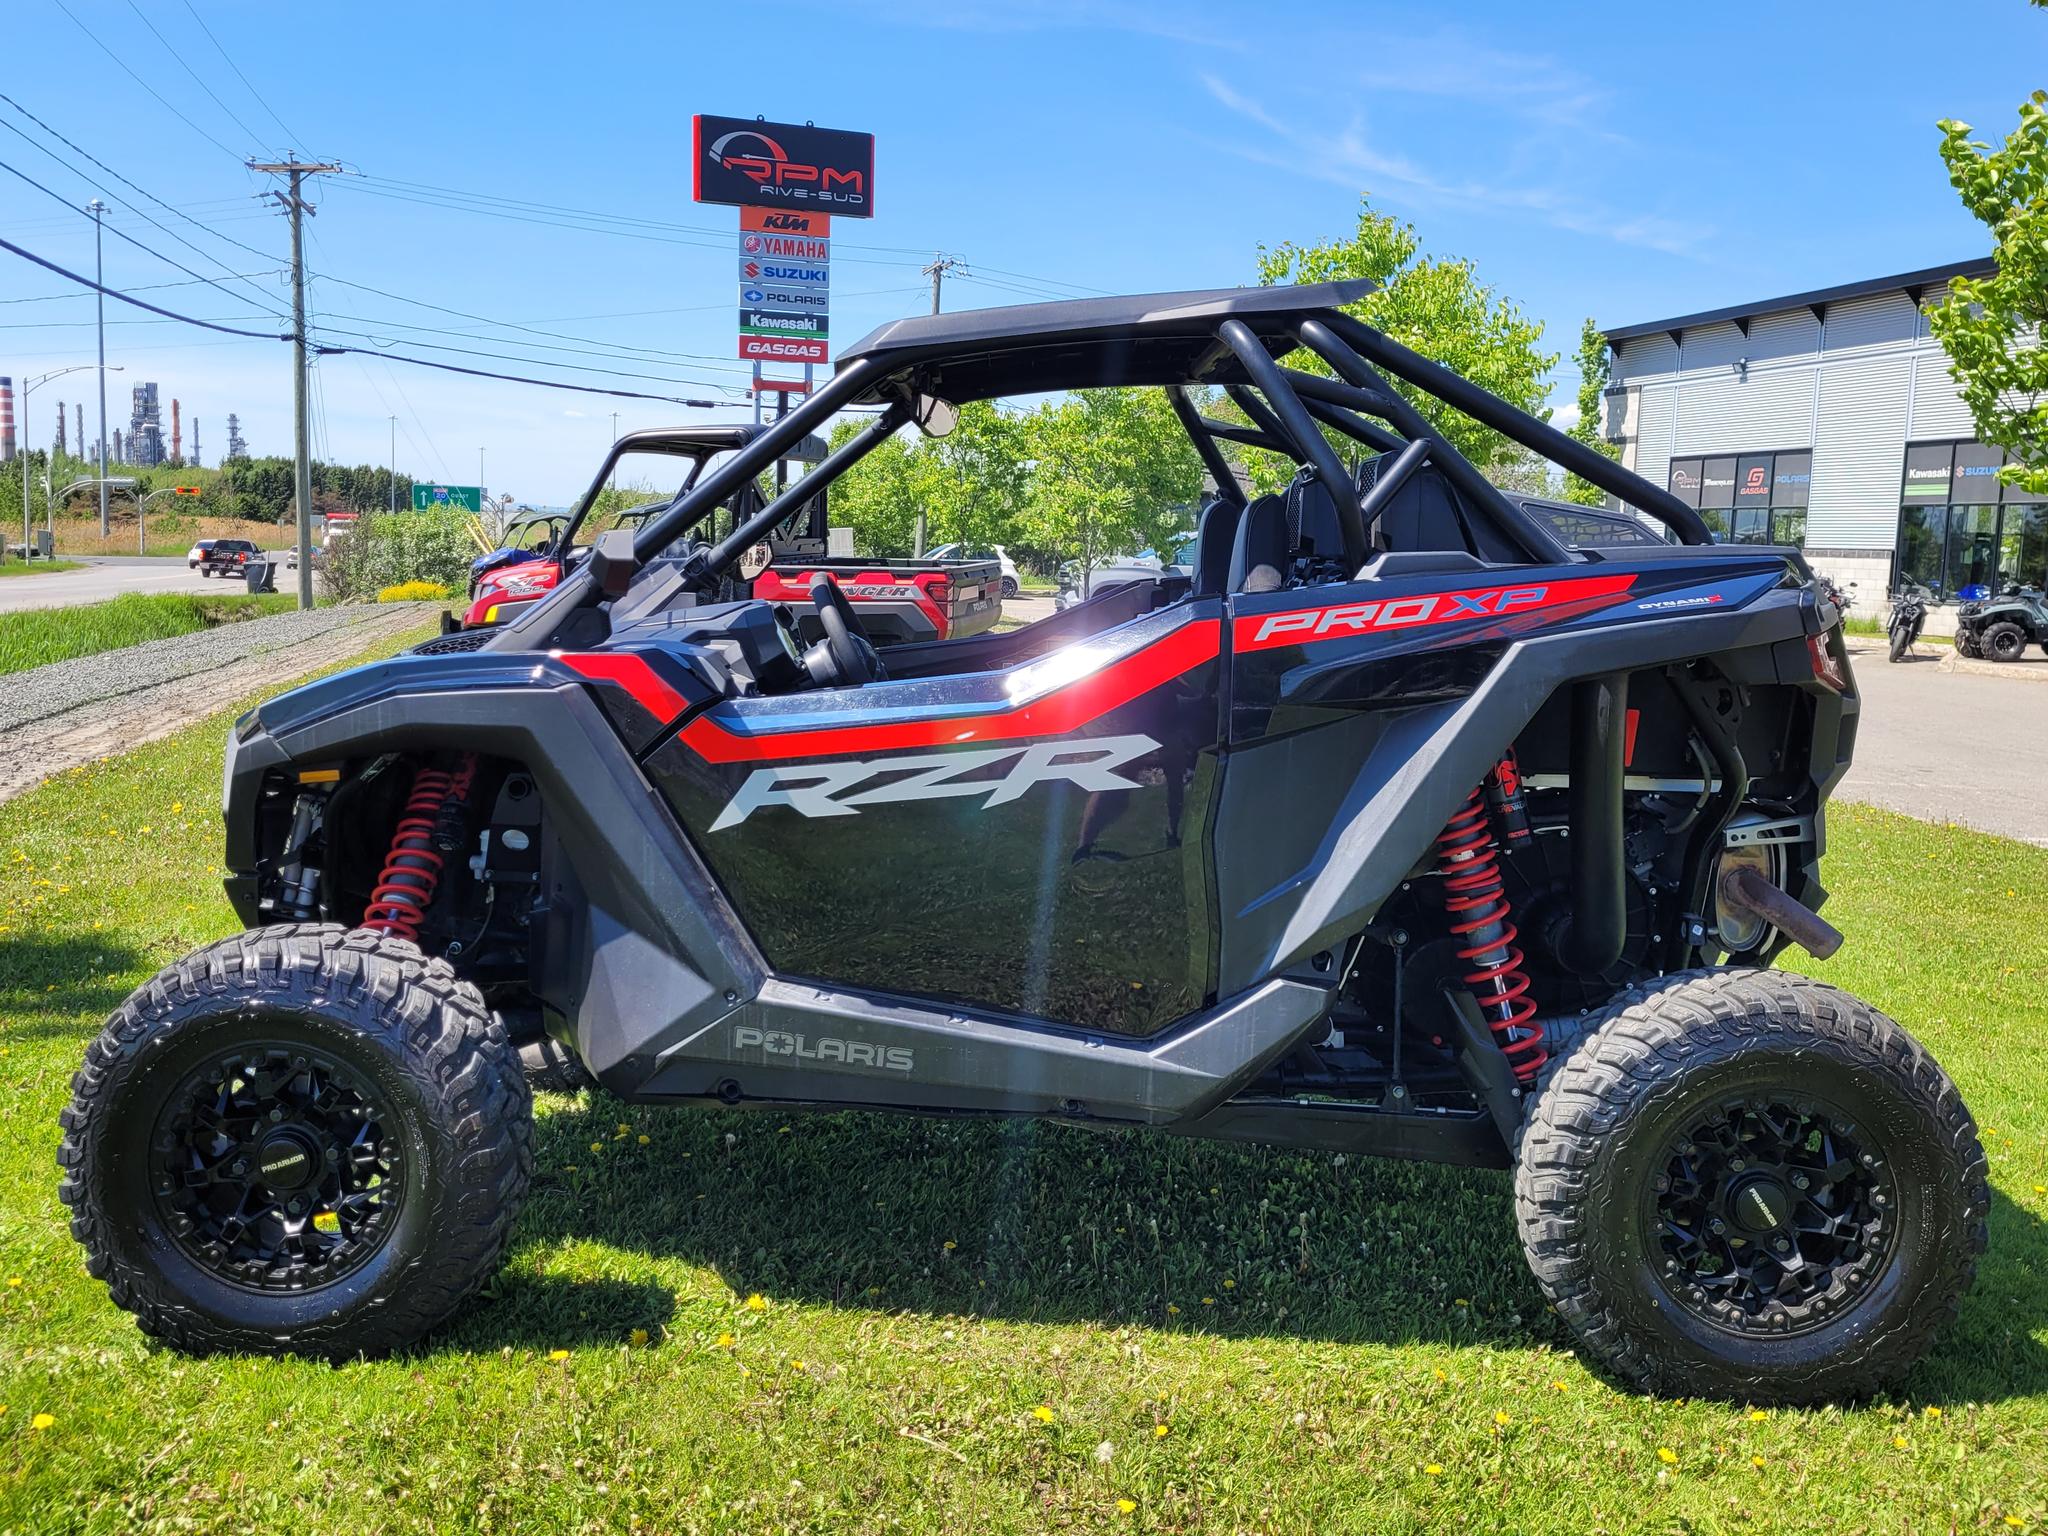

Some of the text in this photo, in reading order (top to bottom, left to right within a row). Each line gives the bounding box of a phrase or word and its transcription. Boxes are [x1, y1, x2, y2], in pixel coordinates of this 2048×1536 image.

[723, 157, 863, 192] RPM
[760, 185, 864, 203] RIVE-SUD
[762, 213, 810, 231] KTM
[763, 237, 827, 259] YAMAHA
[763, 266, 827, 282] SUZUKI
[766, 293, 826, 306] POLARIS
[750, 314, 818, 331] Kawasaki
[747, 342, 822, 357] GASGAS
[1775, 474, 1809, 484] POLARIS
[1909, 467, 1951, 479] Kawasaki
[1965, 465, 2000, 476] SUZUK
[1740, 487, 1769, 495] GASGAS
[1254, 587, 1549, 641] PRO XP
[708, 734, 1163, 833] RZR
[734, 1027, 914, 1072] POLARIS
[261, 1153, 305, 1173] PRO ARMOR
